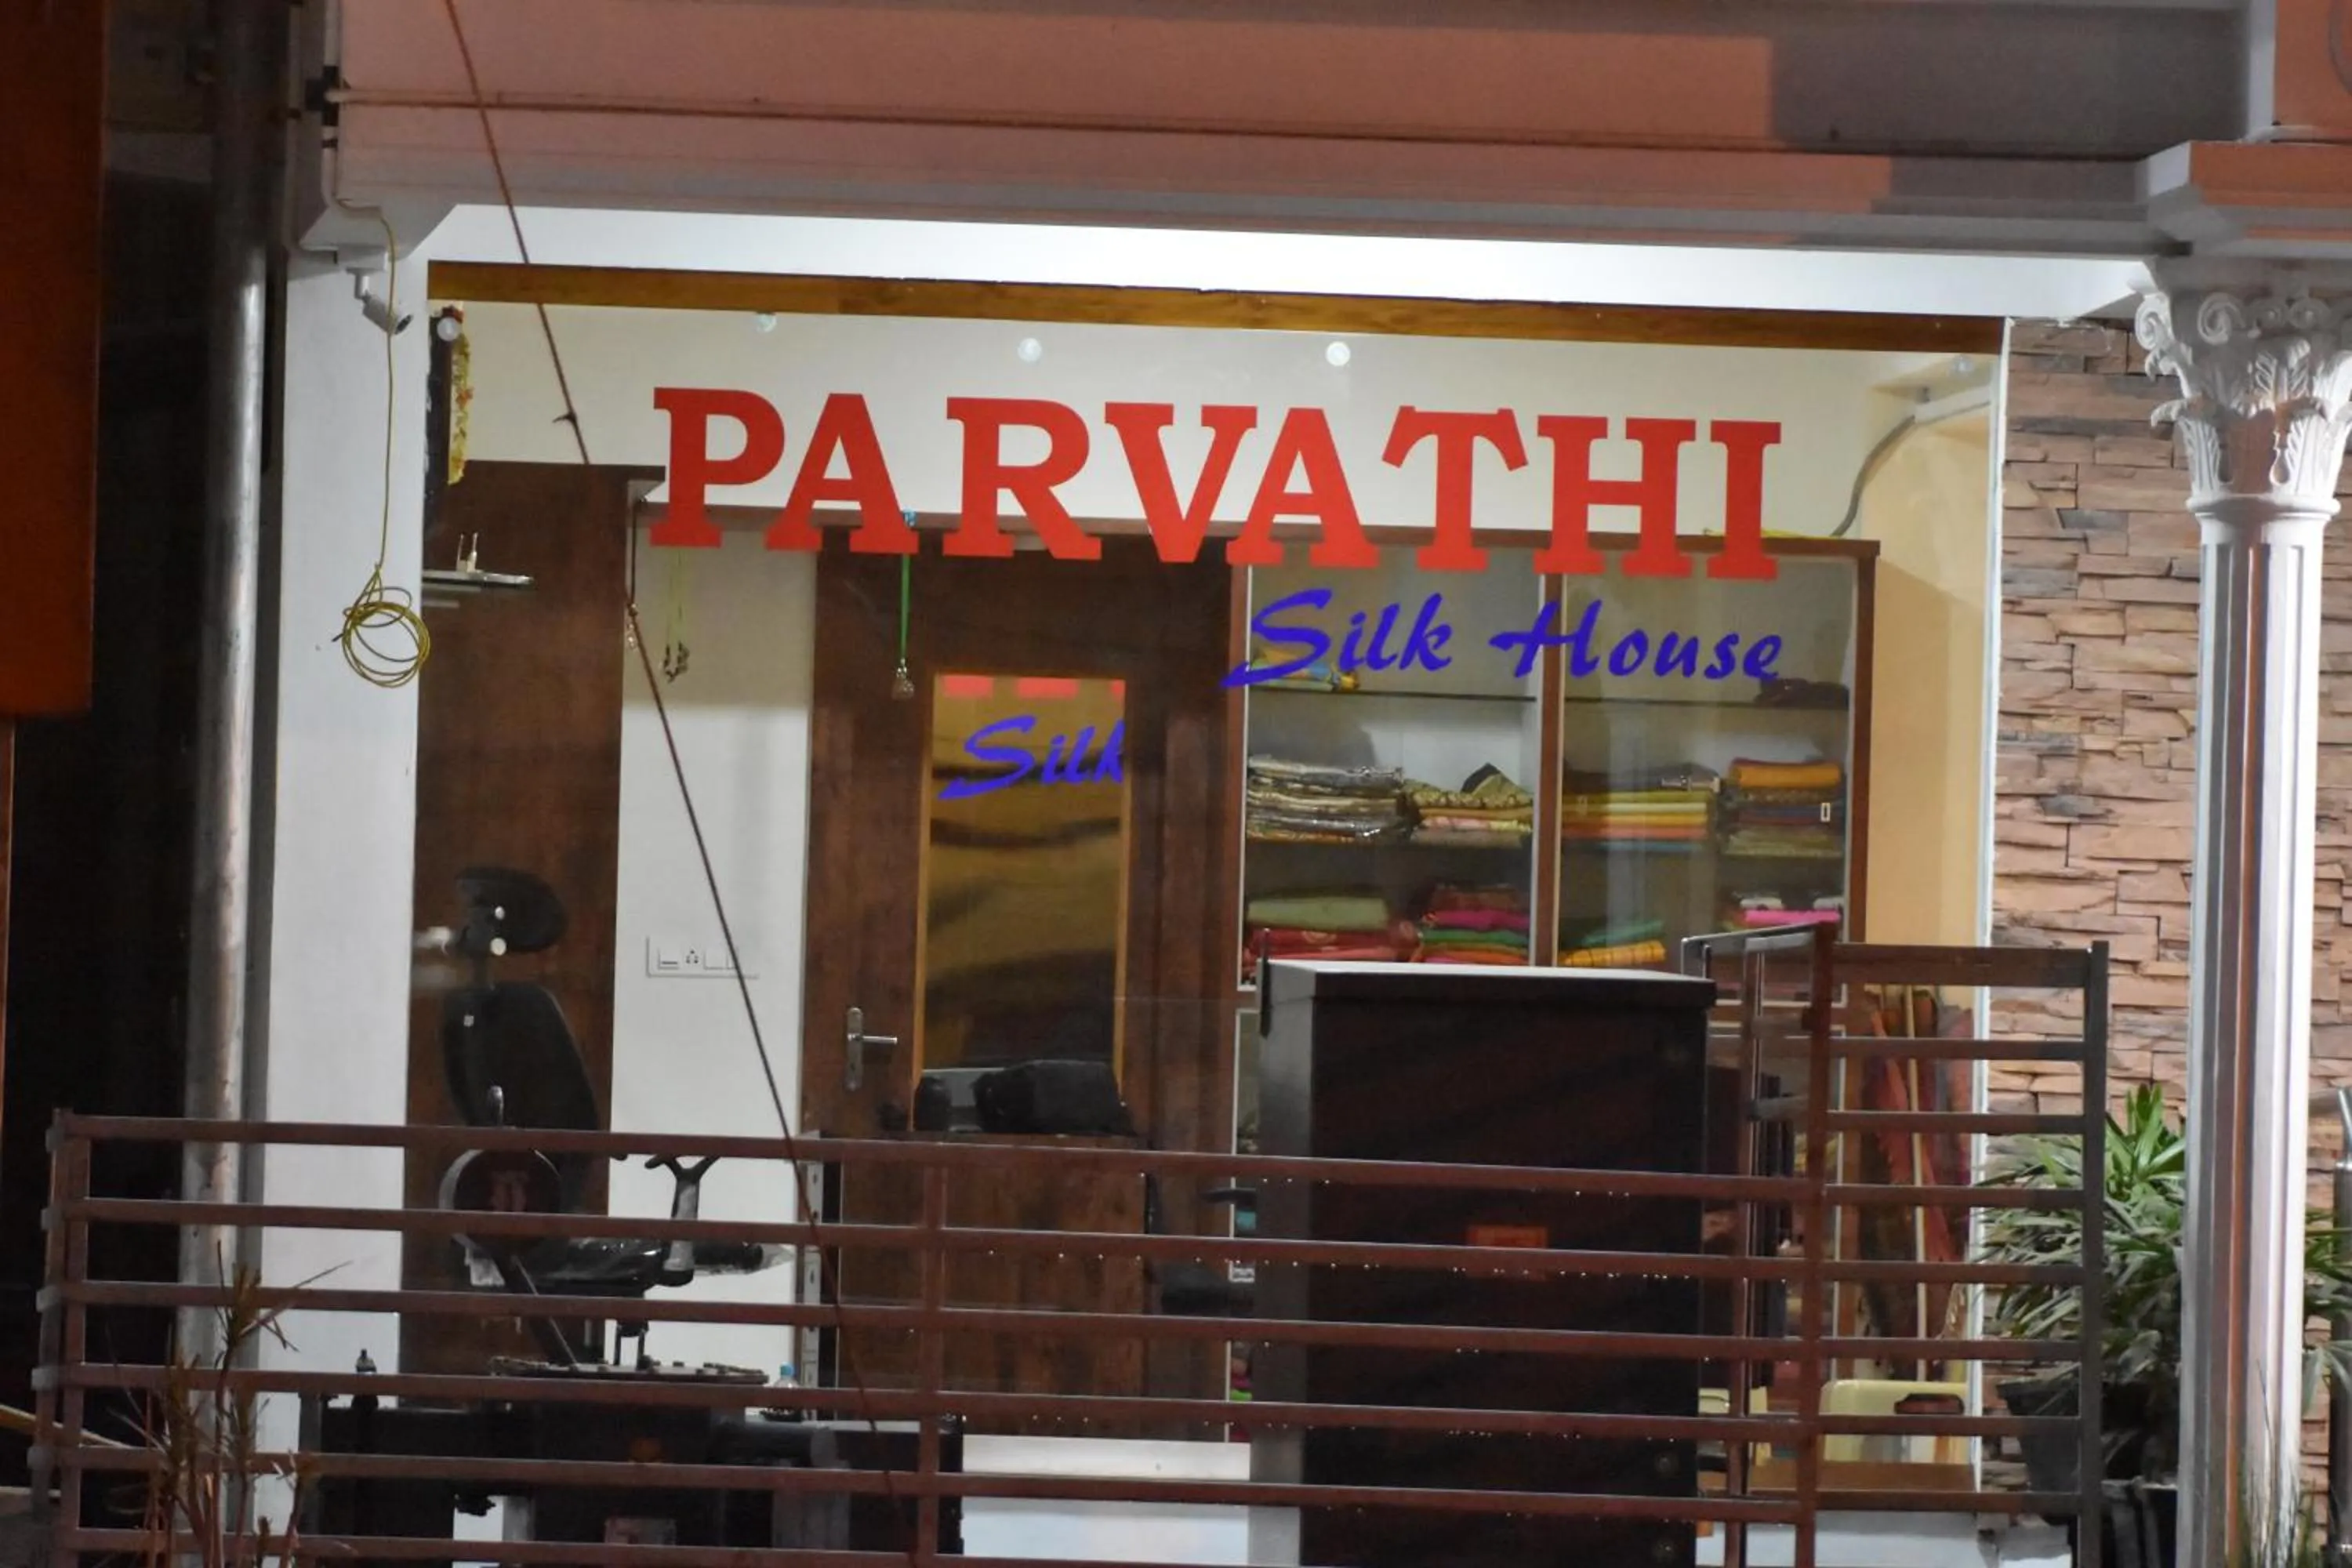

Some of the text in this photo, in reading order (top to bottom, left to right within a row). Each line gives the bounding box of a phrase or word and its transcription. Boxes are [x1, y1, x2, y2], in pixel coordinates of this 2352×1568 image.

[649, 387, 1782, 581] PARVATHI
[1220, 589, 1783, 688] Silk House
